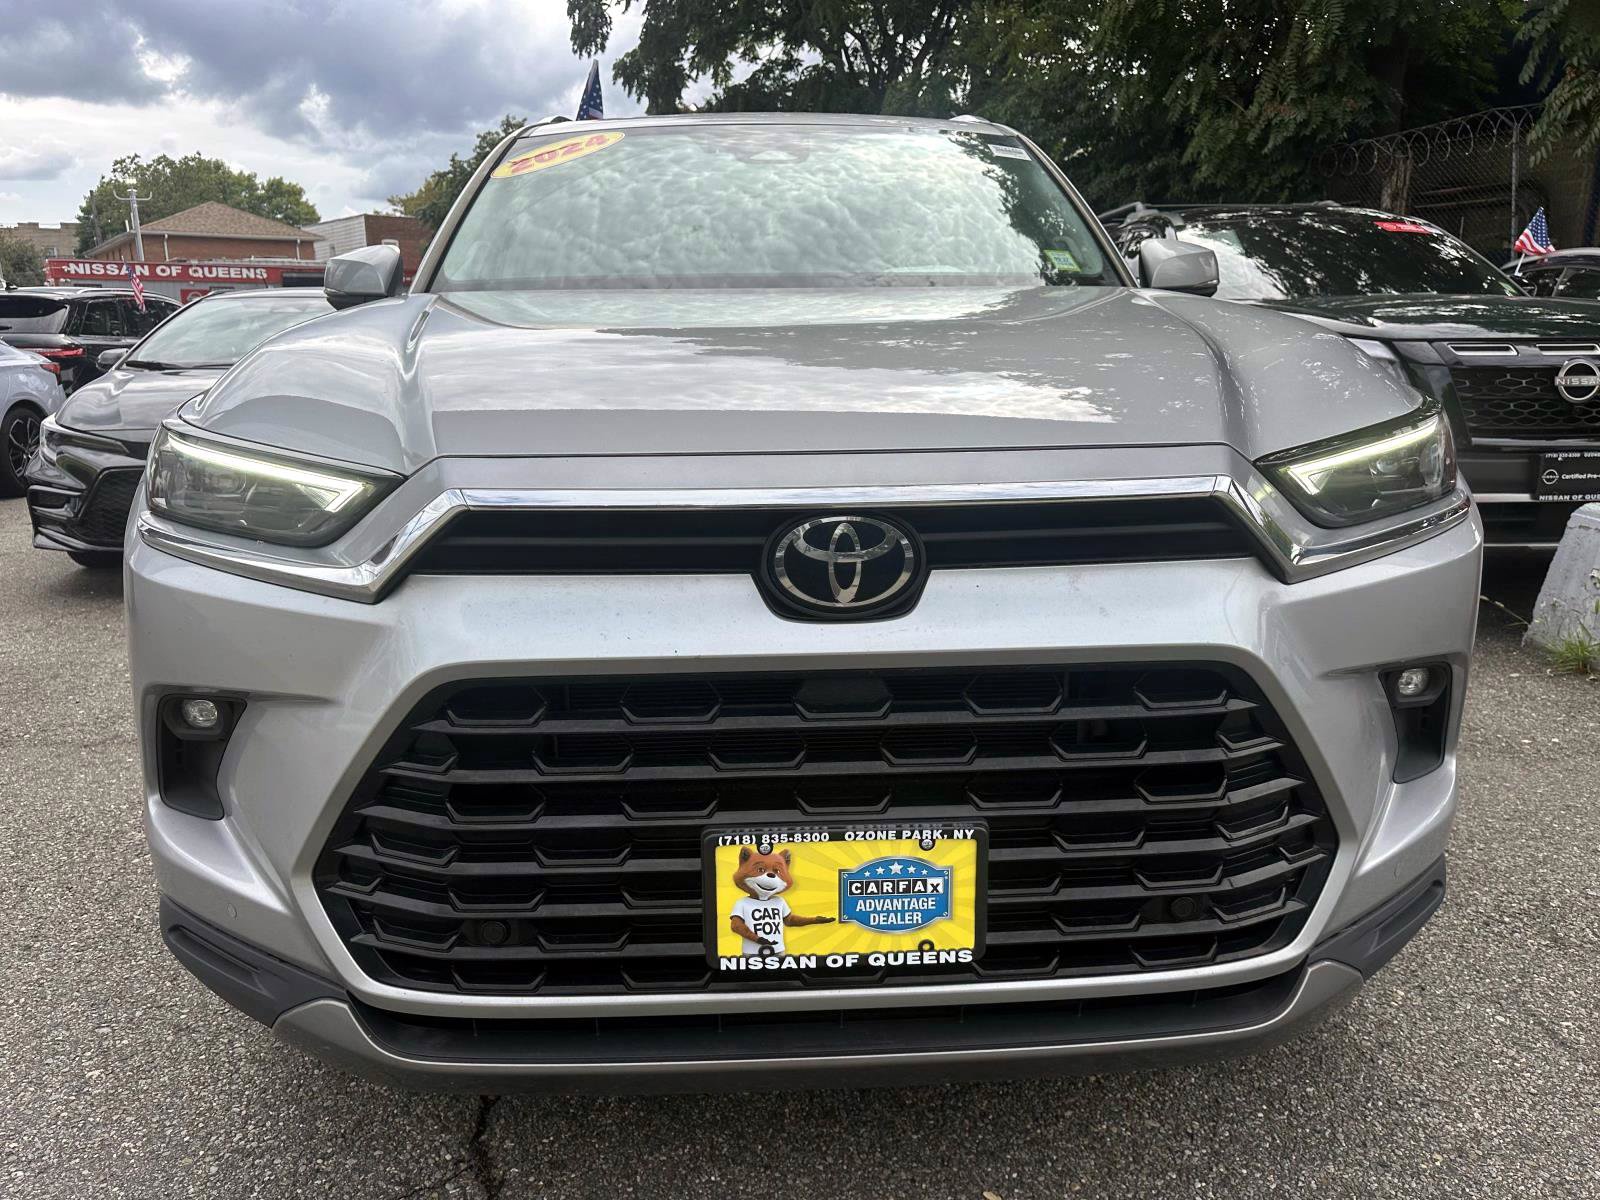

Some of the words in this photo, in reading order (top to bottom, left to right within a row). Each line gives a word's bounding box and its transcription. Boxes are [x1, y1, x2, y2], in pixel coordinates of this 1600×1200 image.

[68, 262, 150, 276] NISSAN
[155, 265, 182, 277] OF
[188, 266, 268, 279] QUEENS
[718, 834, 756, 846] (718)
[761, 832, 830, 844] 835-8300
[844, 830, 896, 841] OZONE
[902, 829, 948, 840] PARK,
[953, 829, 975, 840] NY
[850, 880, 942, 894] CARFAX
[855, 897, 936, 912] ADVANTAGE
[751, 907, 781, 922] CAR
[869, 912, 922, 926] DEALER
[753, 921, 781, 935] FOX
[720, 955, 817, 971] NISSAN
[825, 954, 860, 968] OF
[867, 949, 973, 967] QUEENS
